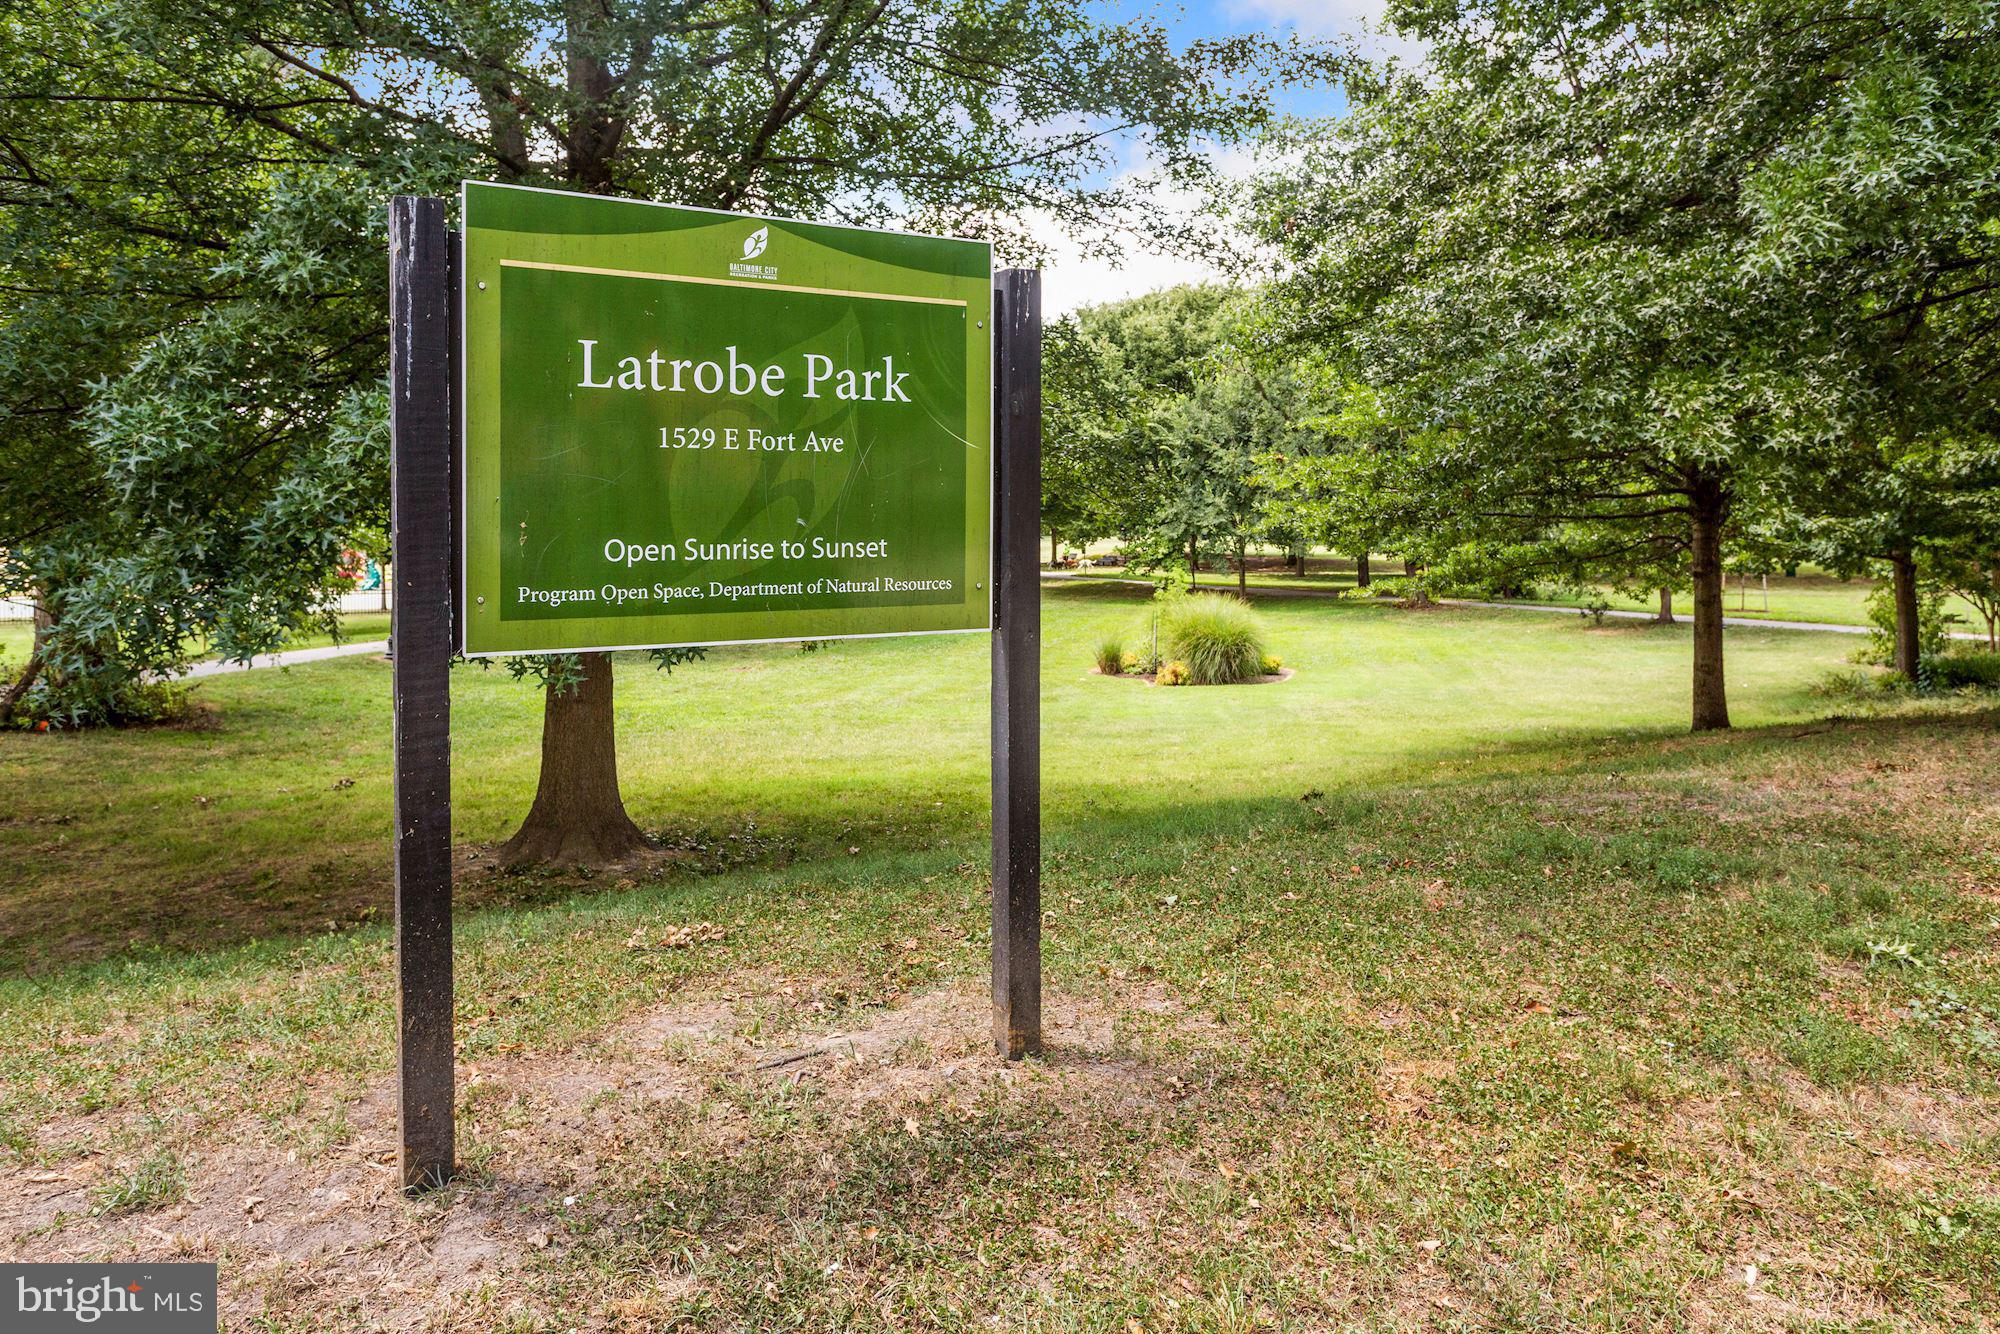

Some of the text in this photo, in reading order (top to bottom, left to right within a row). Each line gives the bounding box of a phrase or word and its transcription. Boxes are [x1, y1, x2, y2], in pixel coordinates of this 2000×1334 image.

[729, 262, 778, 275] BALTIMORE CITY
[577, 339, 912, 403] Latrobe Park
[659, 427, 844, 453] 1529 E Fort Ave
[604, 536, 888, 568] Open Sunrise to Sunset
[517, 576, 952, 606] Program Open Space, Department of Natural Resources
